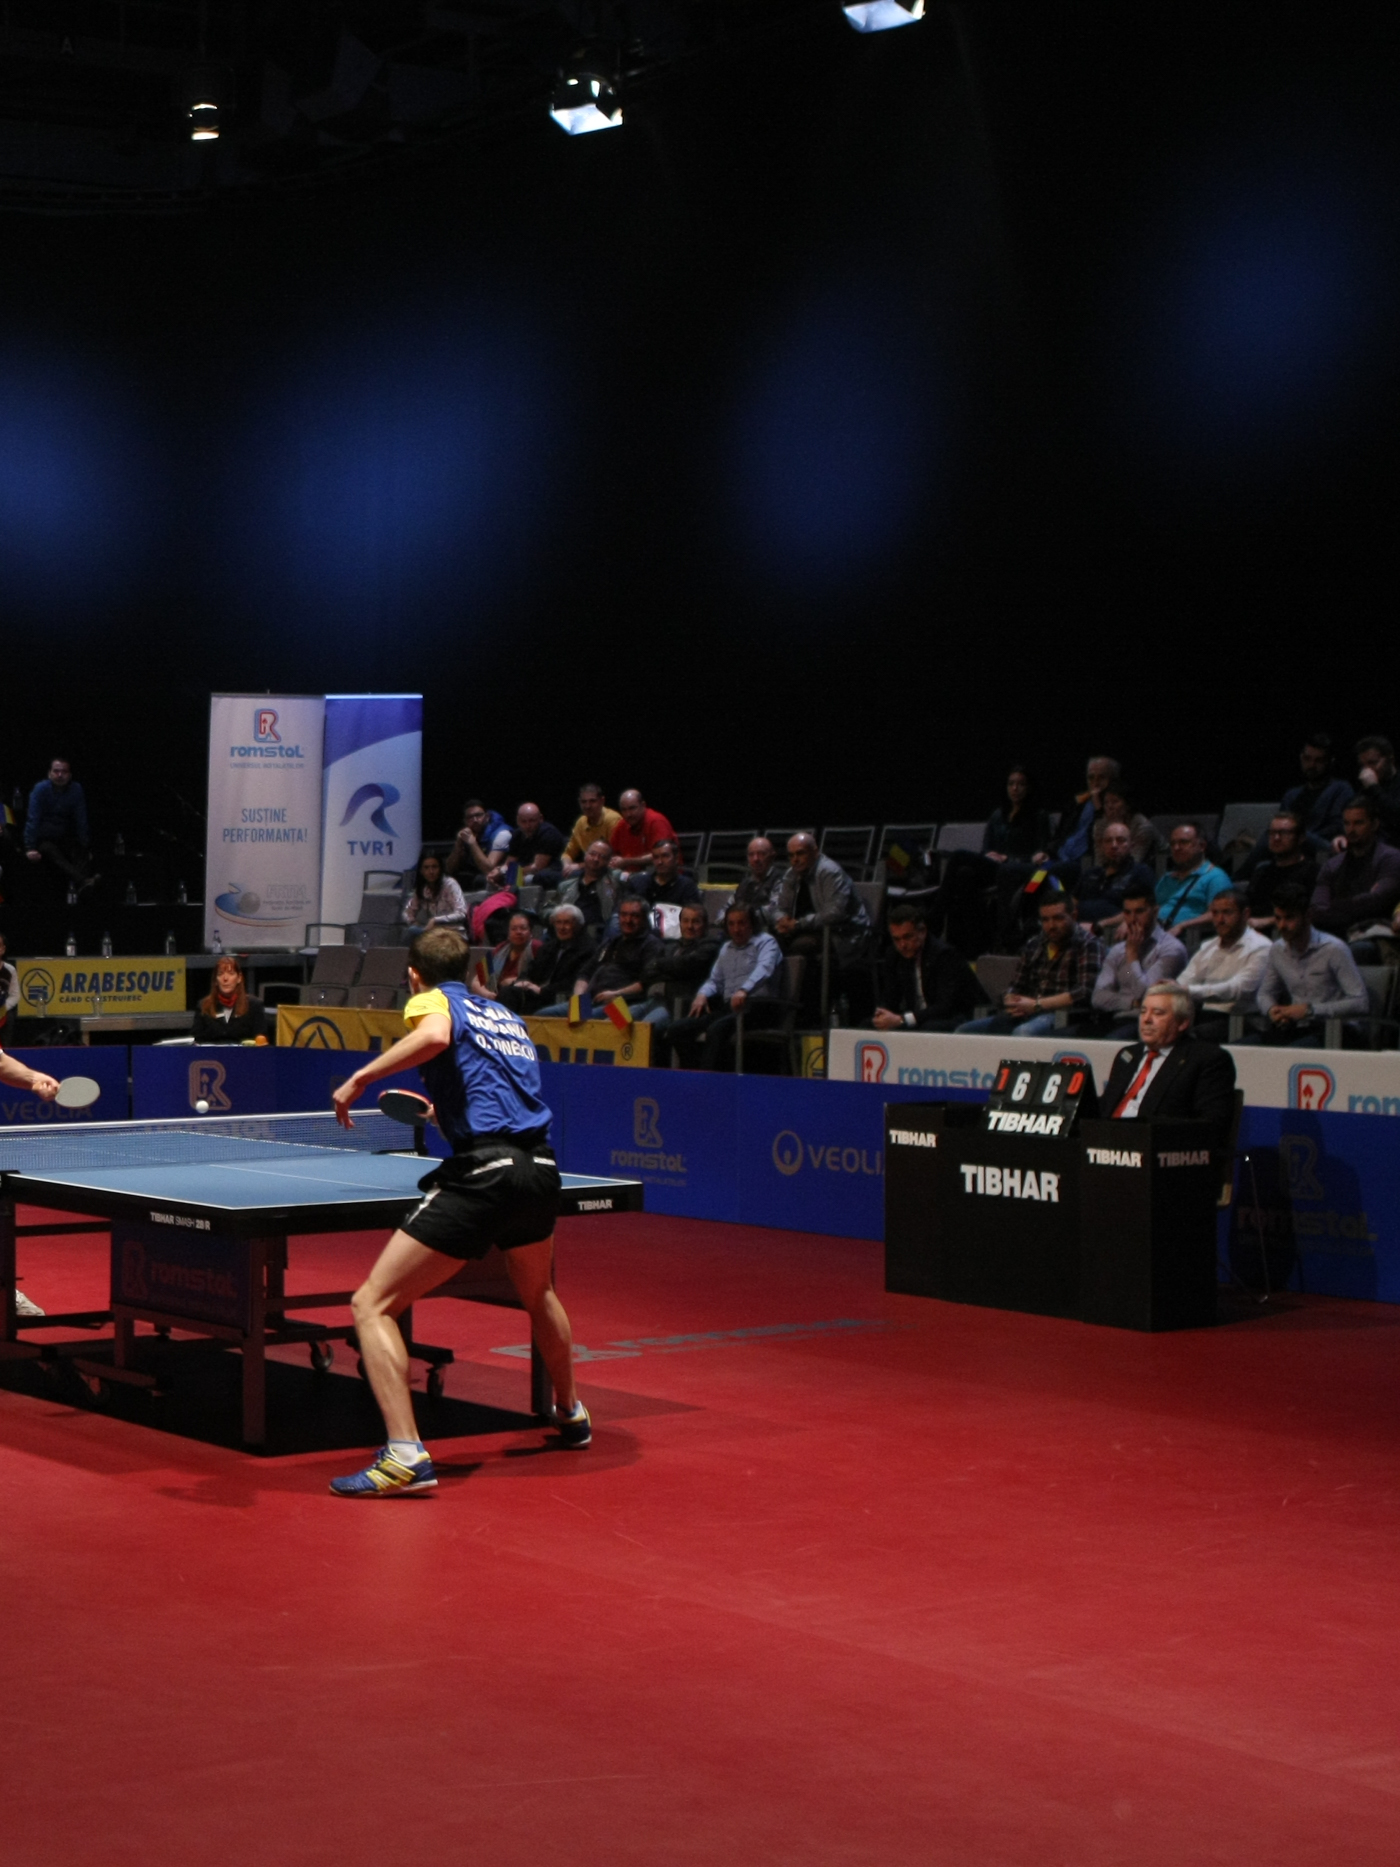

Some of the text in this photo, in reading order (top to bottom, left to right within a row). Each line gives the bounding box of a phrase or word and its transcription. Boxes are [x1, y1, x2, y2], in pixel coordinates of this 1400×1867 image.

[347, 840, 394, 856] TVR1
[59, 971, 176, 994] ARABESQUE
[1011, 1071, 1032, 1102] 6
[1042, 1073, 1062, 1104] 6
[1066, 1071, 1085, 1095] 0
[987, 1110, 1064, 1135] TIBHAR
[888, 1129, 938, 1148] TIBHAR
[807, 1144, 885, 1175] VEOLI
[1086, 1147, 1143, 1169] TIBHAR
[1157, 1150, 1211, 1168] TIBHAR
[960, 1163, 1061, 1203] TIBHAR
[578, 1198, 613, 1212] TIBHAR
[150, 1211, 175, 1225] TIBHAR
